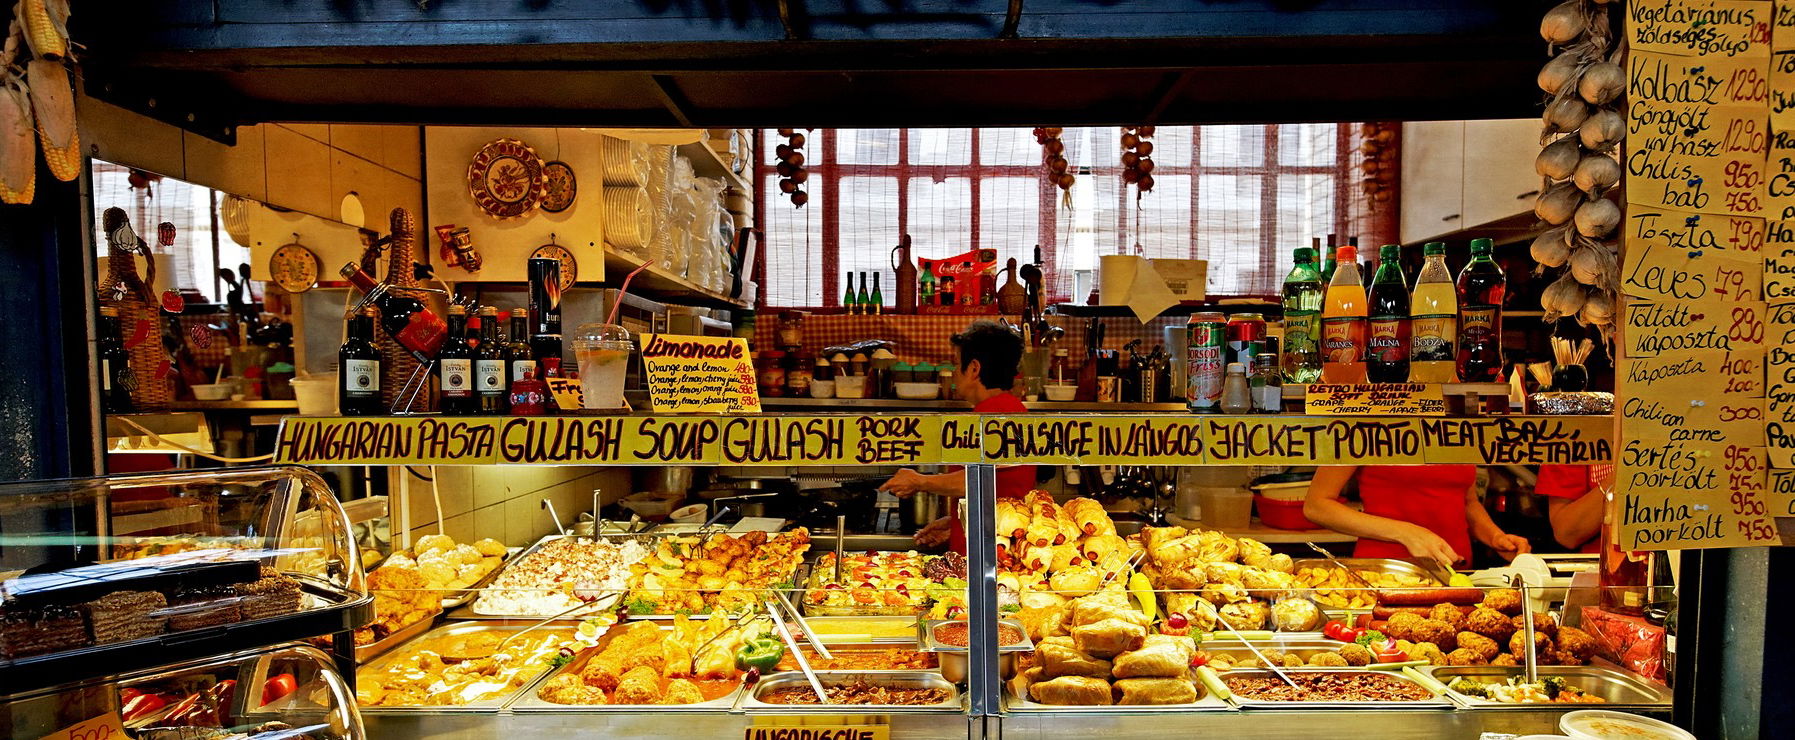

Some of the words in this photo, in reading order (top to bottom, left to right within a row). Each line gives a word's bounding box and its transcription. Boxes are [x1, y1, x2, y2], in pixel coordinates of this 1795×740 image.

[1629, 55, 1724, 104] Kolbász
[1661, 182, 1709, 209] bab
[1625, 244, 1706, 299] Leves
[642, 333, 743, 359] Limonade
[648, 361, 681, 376] Orange
[682, 363, 700, 372] and
[701, 362, 730, 373] lemon
[1627, 357, 1706, 386] Káposzta
[1308, 384, 1350, 394] RETRO
[1353, 384, 1426, 393] HUNGARIAN
[1623, 397, 1662, 420] Chili
[1662, 413, 1684, 427] con
[275, 420, 413, 463] HUNGARIAN
[417, 418, 495, 460] PASTA
[500, 417, 622, 463] GULASH
[633, 418, 720, 461] SOUP
[722, 417, 844, 464] GULASH
[857, 416, 922, 439] PORK
[941, 420, 981, 449] Chili
[984, 419, 1092, 460] SAUSAGE
[1098, 424, 1122, 456] IN
[1209, 420, 1321, 461] JACKET
[1326, 419, 1420, 461] POTATO
[1421, 420, 1499, 449] MEAT
[1498, 418, 1581, 442] BALL,
[1670, 428, 1726, 442] carne
[855, 439, 924, 463] BEEF
[1623, 439, 1697, 472] Sertés
[1628, 466, 1719, 491] pörkölt
[1623, 493, 1693, 526] Marha
[1633, 513, 1725, 549] pörkölt
